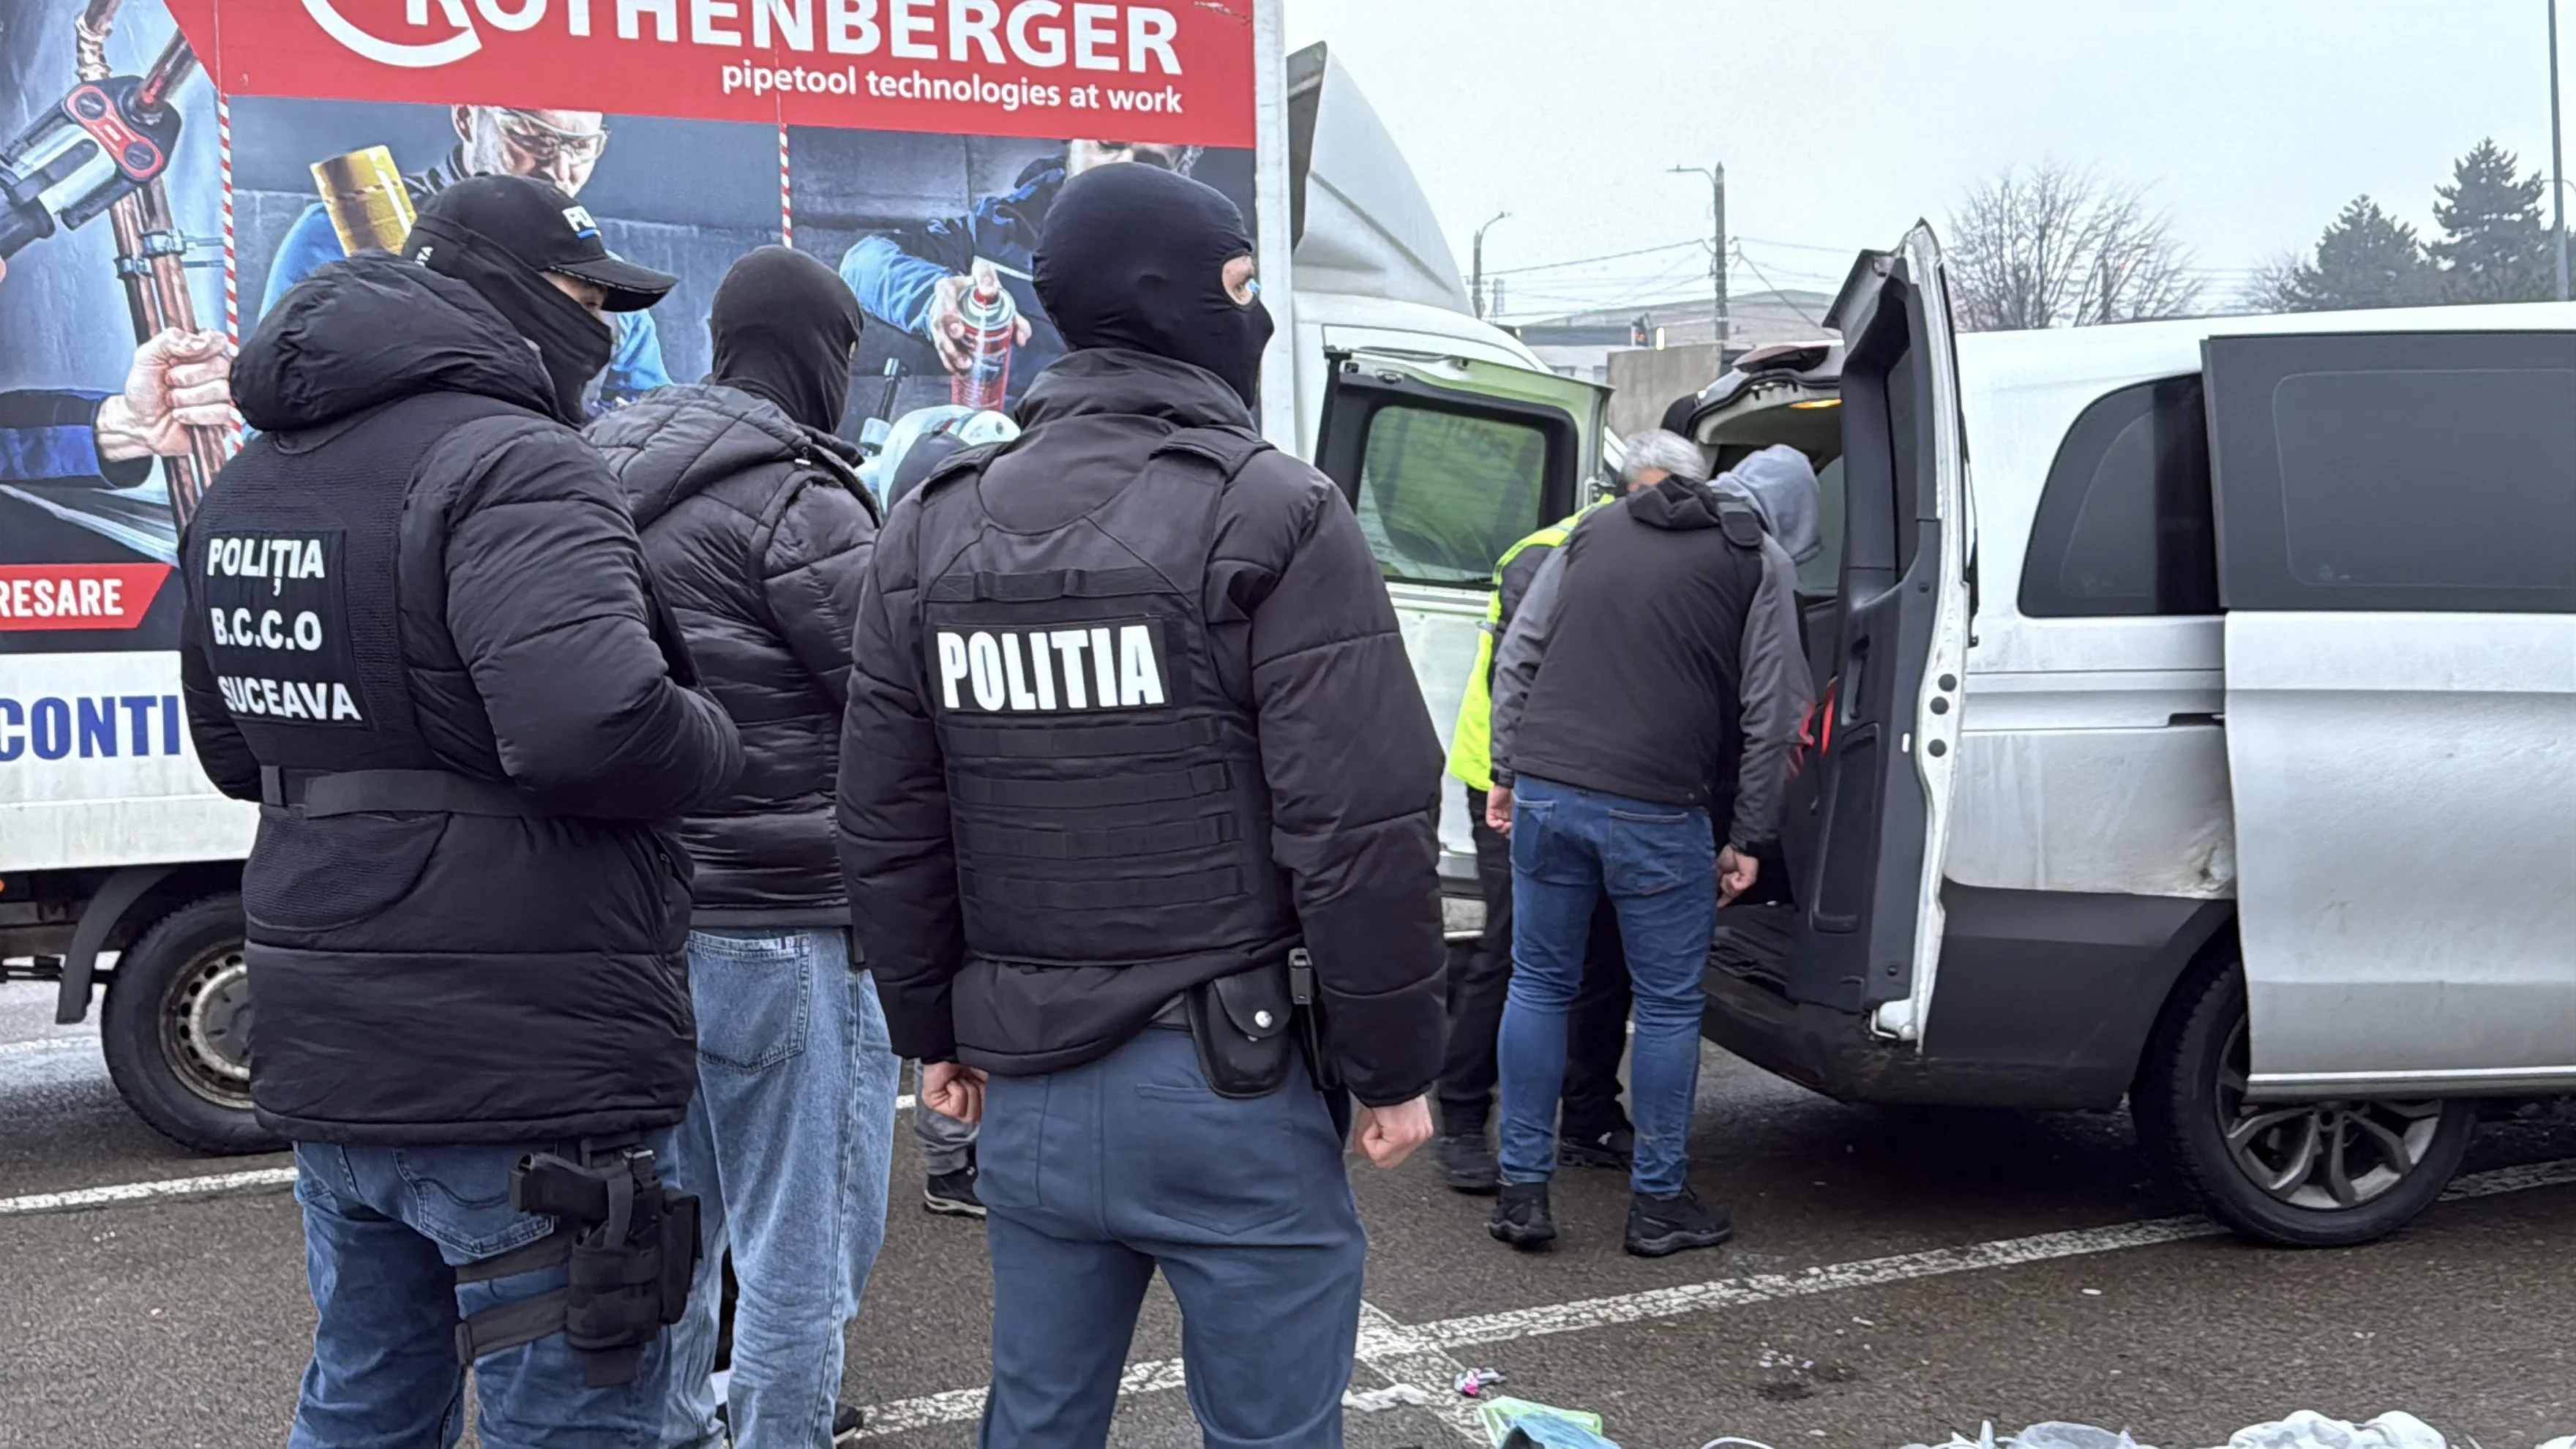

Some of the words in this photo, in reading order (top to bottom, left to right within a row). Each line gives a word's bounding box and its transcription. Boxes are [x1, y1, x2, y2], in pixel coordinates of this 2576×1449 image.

[722, 59, 856, 97] pipetool
[865, 70, 1061, 111] technologies
[1069, 85, 1100, 110] at
[1107, 86, 1183, 113] work
[206, 537, 326, 596] POLIȚIA
[209, 607, 323, 651] B.C.C.O
[937, 625, 1165, 711] POLITIA
[217, 675, 363, 721] SUCEAVA
